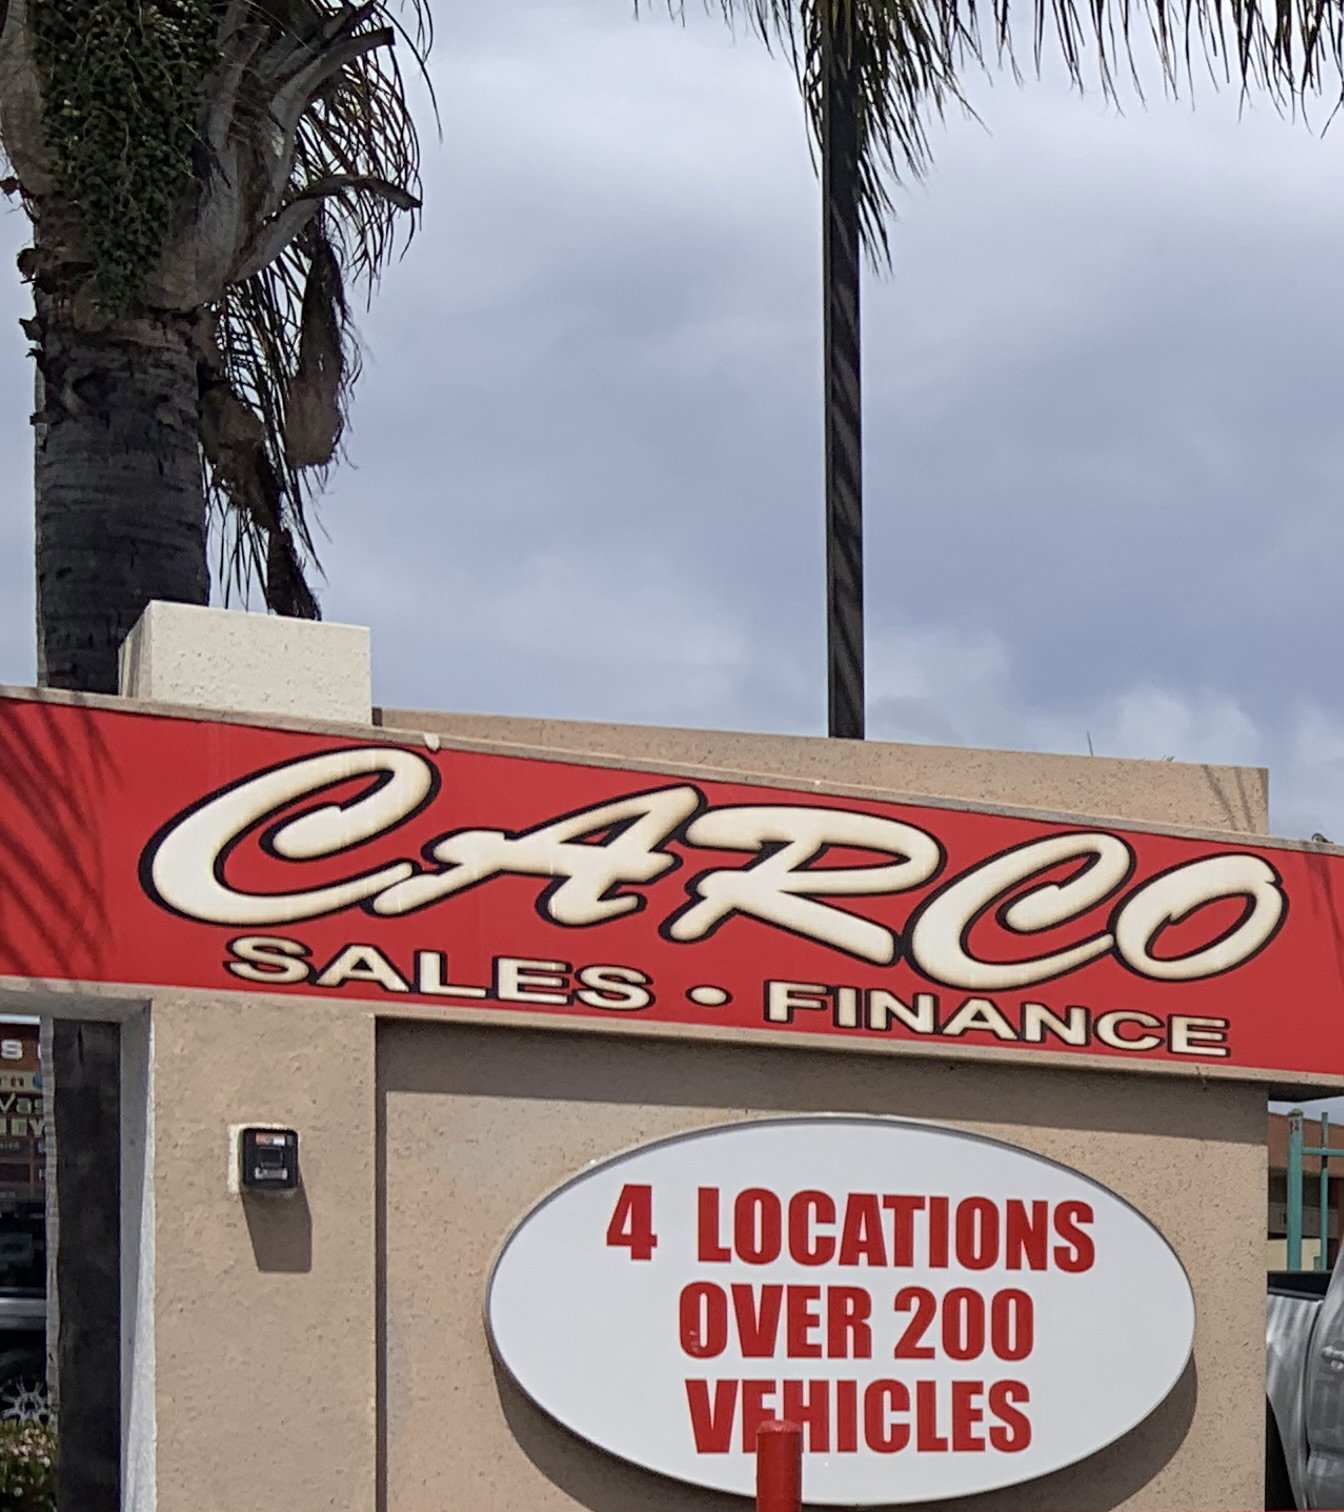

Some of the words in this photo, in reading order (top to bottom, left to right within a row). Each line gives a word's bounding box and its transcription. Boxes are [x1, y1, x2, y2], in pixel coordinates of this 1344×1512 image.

[138, 746, 1288, 989] CARCO
[223, 934, 655, 1011] SALES
[764, 979, 1231, 1057] FINANCE
[606, 1184, 658, 1261] 4
[697, 1186, 1096, 1273] LOCATIONS
[679, 1281, 872, 1359] OVER
[894, 1286, 1034, 1361] 200
[685, 1379, 1032, 1454] VEHICLES
